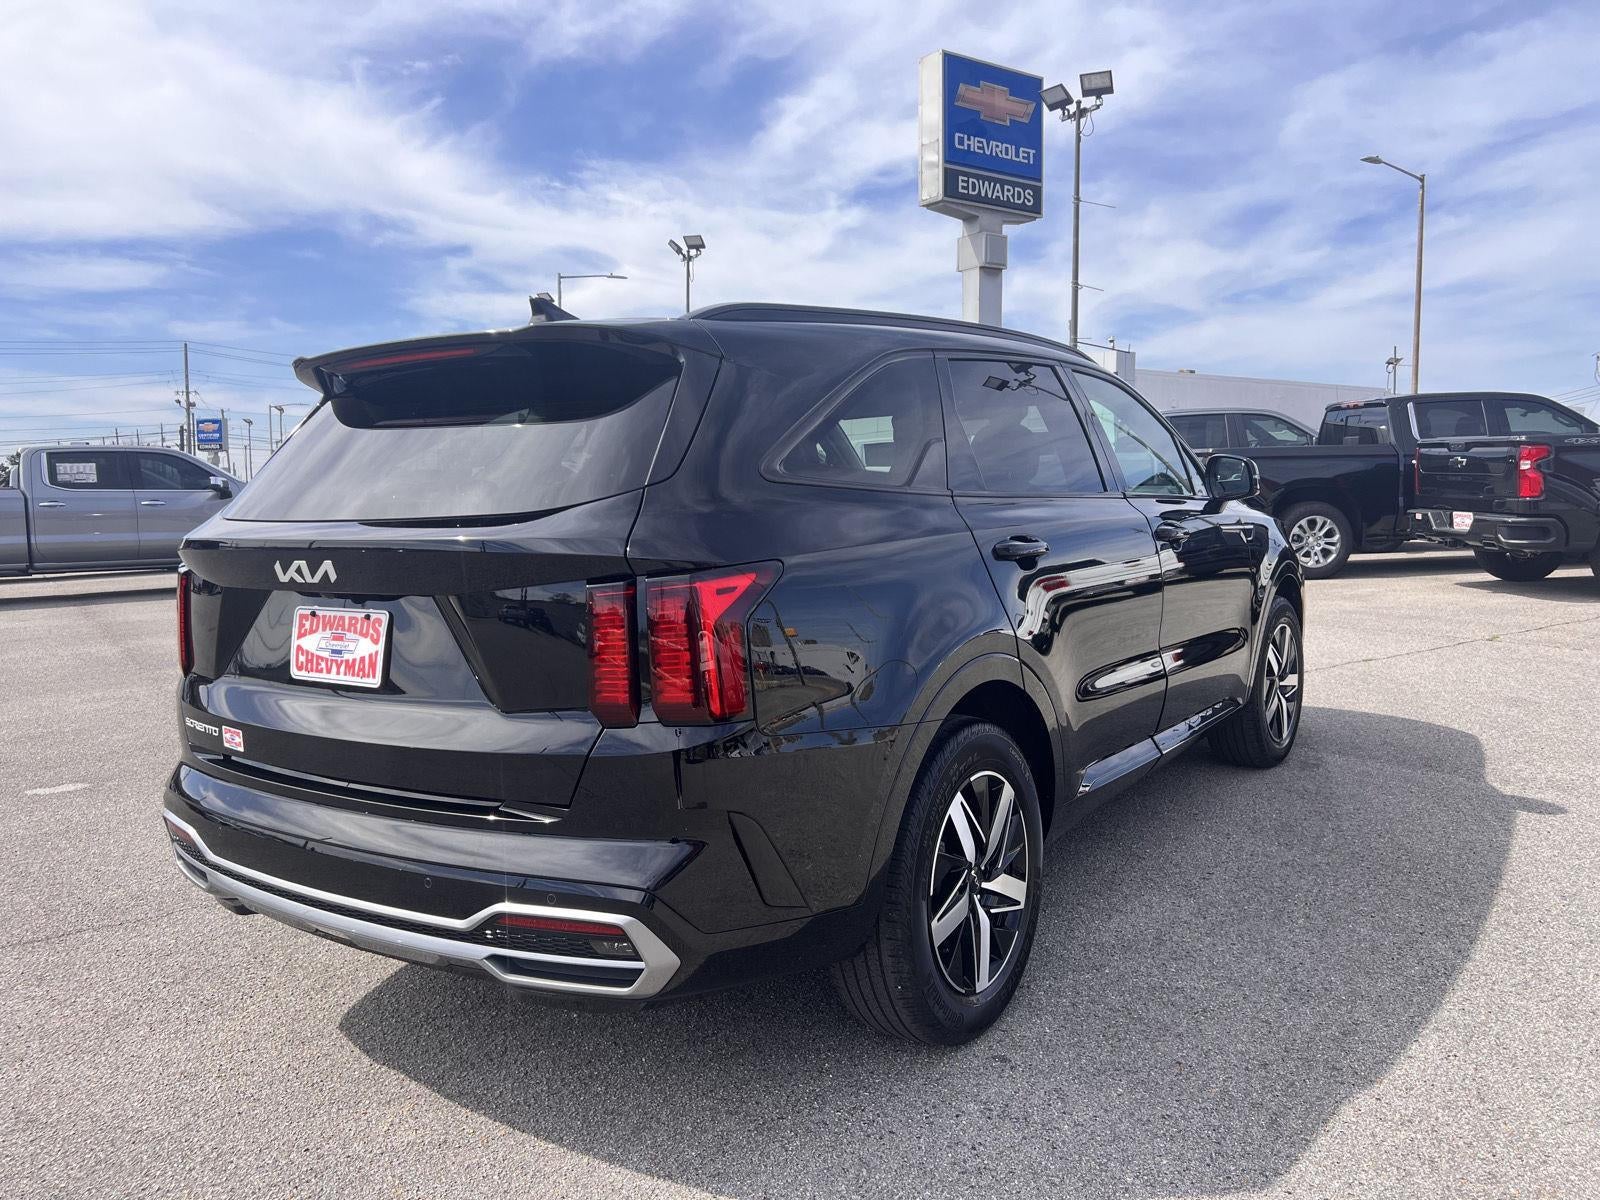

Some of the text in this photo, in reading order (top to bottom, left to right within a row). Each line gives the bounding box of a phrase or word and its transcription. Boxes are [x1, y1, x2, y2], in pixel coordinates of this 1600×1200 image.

[954, 132, 1036, 164] CHEVROLET
[958, 175, 1034, 206] EDWARDS
[296, 613, 382, 645] EDWARDS
[295, 644, 378, 679] CHEVYMAN
[185, 717, 219, 736] SORENTO
